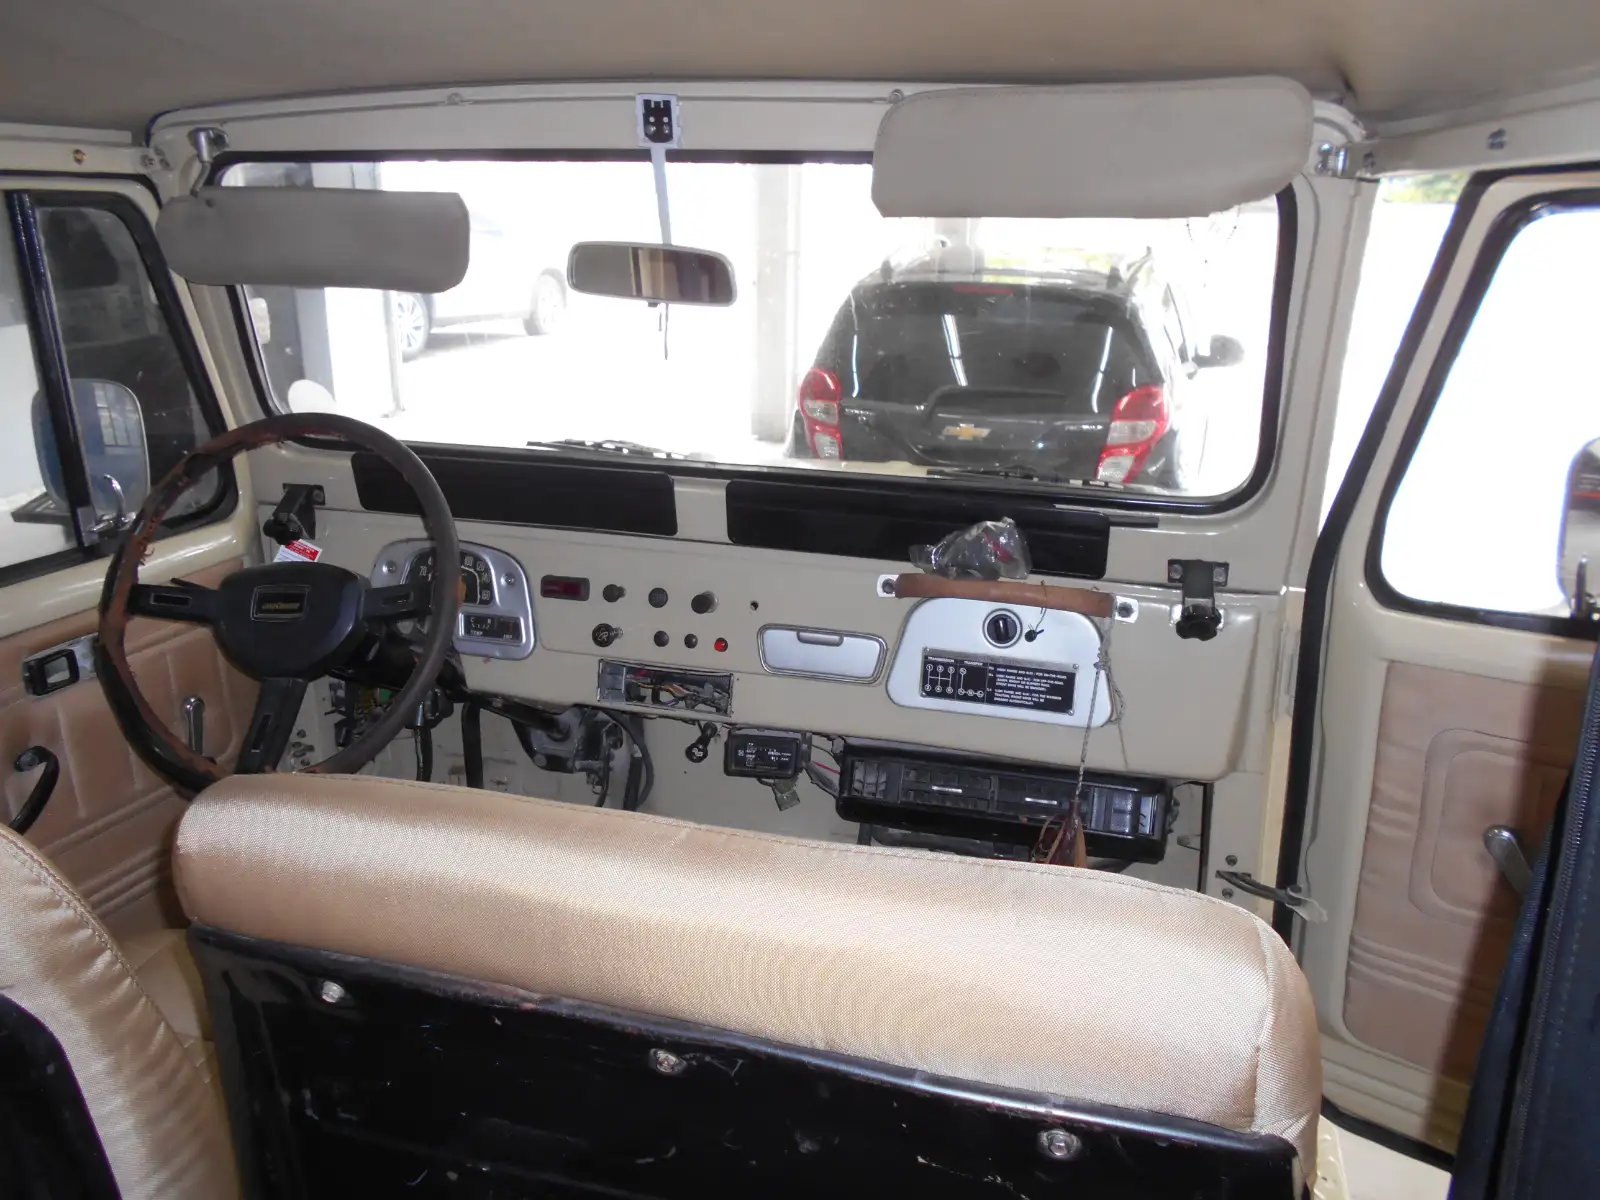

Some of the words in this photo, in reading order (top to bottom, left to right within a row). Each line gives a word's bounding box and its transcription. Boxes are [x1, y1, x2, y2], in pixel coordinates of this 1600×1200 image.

[464, 556, 474, 566] 100
[419, 566, 427, 576] 20
[476, 562, 485, 571] 120
